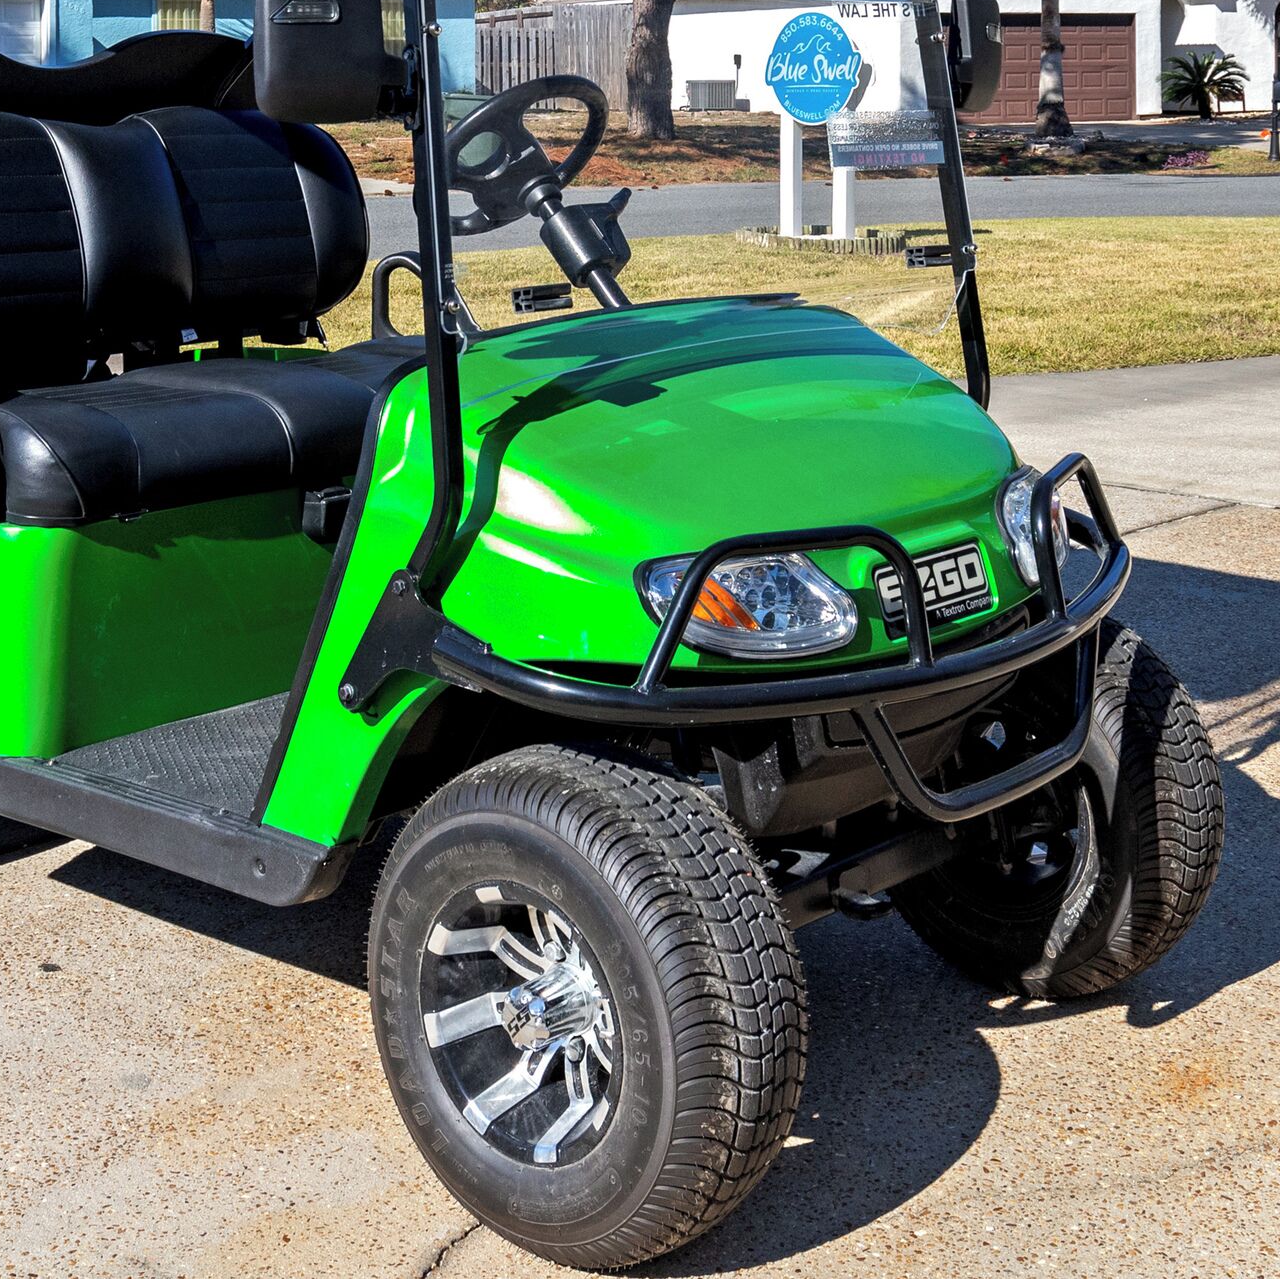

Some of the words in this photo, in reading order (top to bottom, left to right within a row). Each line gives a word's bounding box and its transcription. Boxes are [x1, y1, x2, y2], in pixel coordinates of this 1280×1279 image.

[780, 16, 844, 43] 850.583.6644
[767, 52, 809, 83] Blue
[811, 53, 860, 84] Swell
[783, 99, 842, 120] BLUESWELL.COM
[941, 602, 966, 618] Textron
